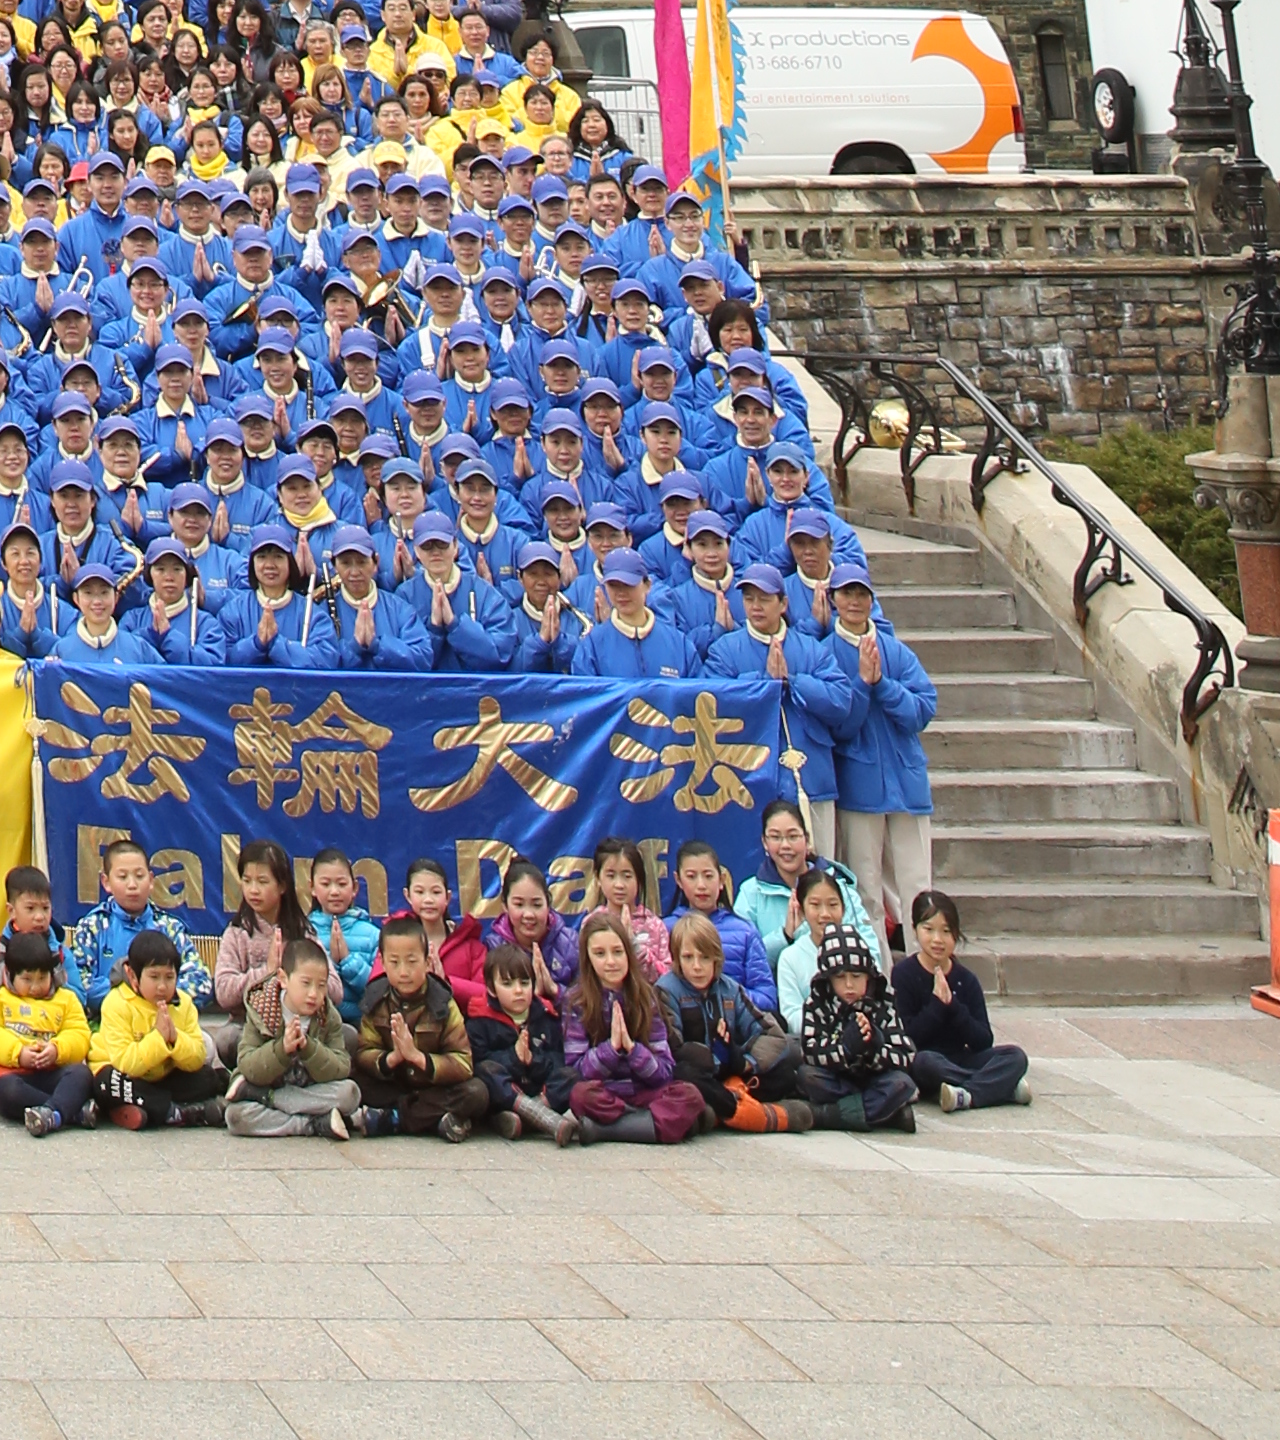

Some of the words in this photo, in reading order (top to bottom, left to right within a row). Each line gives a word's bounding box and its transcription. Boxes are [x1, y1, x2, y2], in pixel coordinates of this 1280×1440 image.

[770, 30, 910, 49] productions
[768, 92, 854, 104] entertainment
[858, 93, 910, 104] solutions
[42, 681, 770, 820] 法輪大法
[455, 838, 733, 918] Daf
